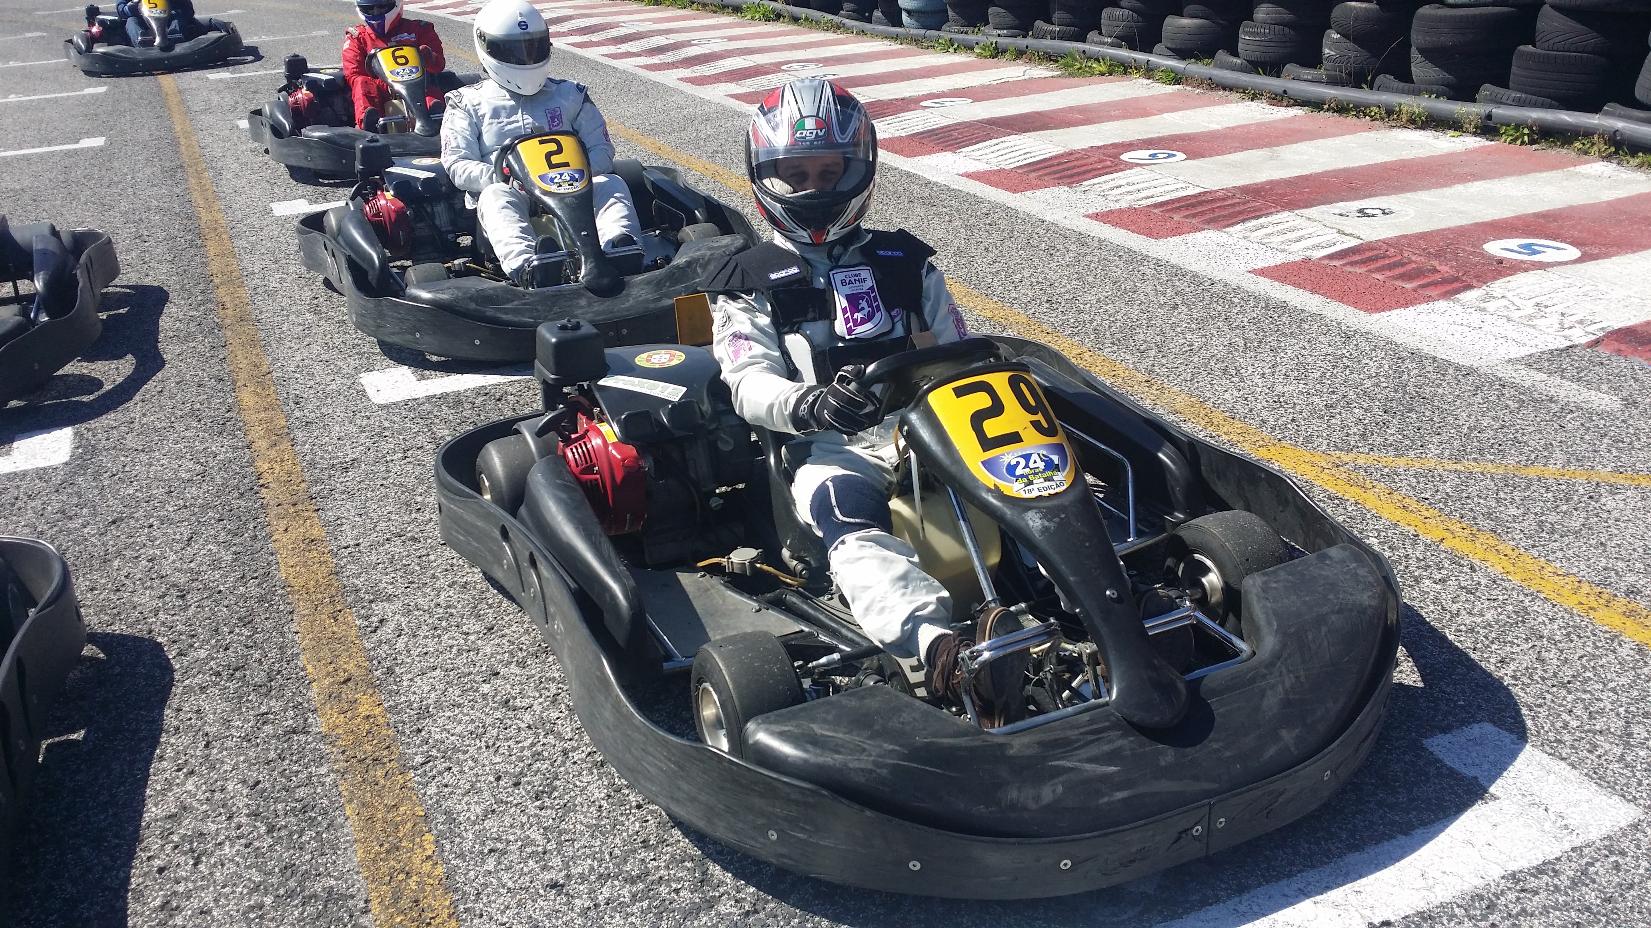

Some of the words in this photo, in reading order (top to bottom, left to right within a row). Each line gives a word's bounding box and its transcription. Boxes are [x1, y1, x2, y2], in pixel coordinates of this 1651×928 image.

[391, 47, 409, 66] 6
[538, 138, 570, 170] 2
[553, 172, 571, 183] 24
[841, 278, 868, 287] BANIF
[952, 374, 1058, 453] 29
[1010, 453, 1045, 476] 24
[1029, 470, 1059, 481] Batalha
[1037, 481, 1066, 493] EDIÇÃO
